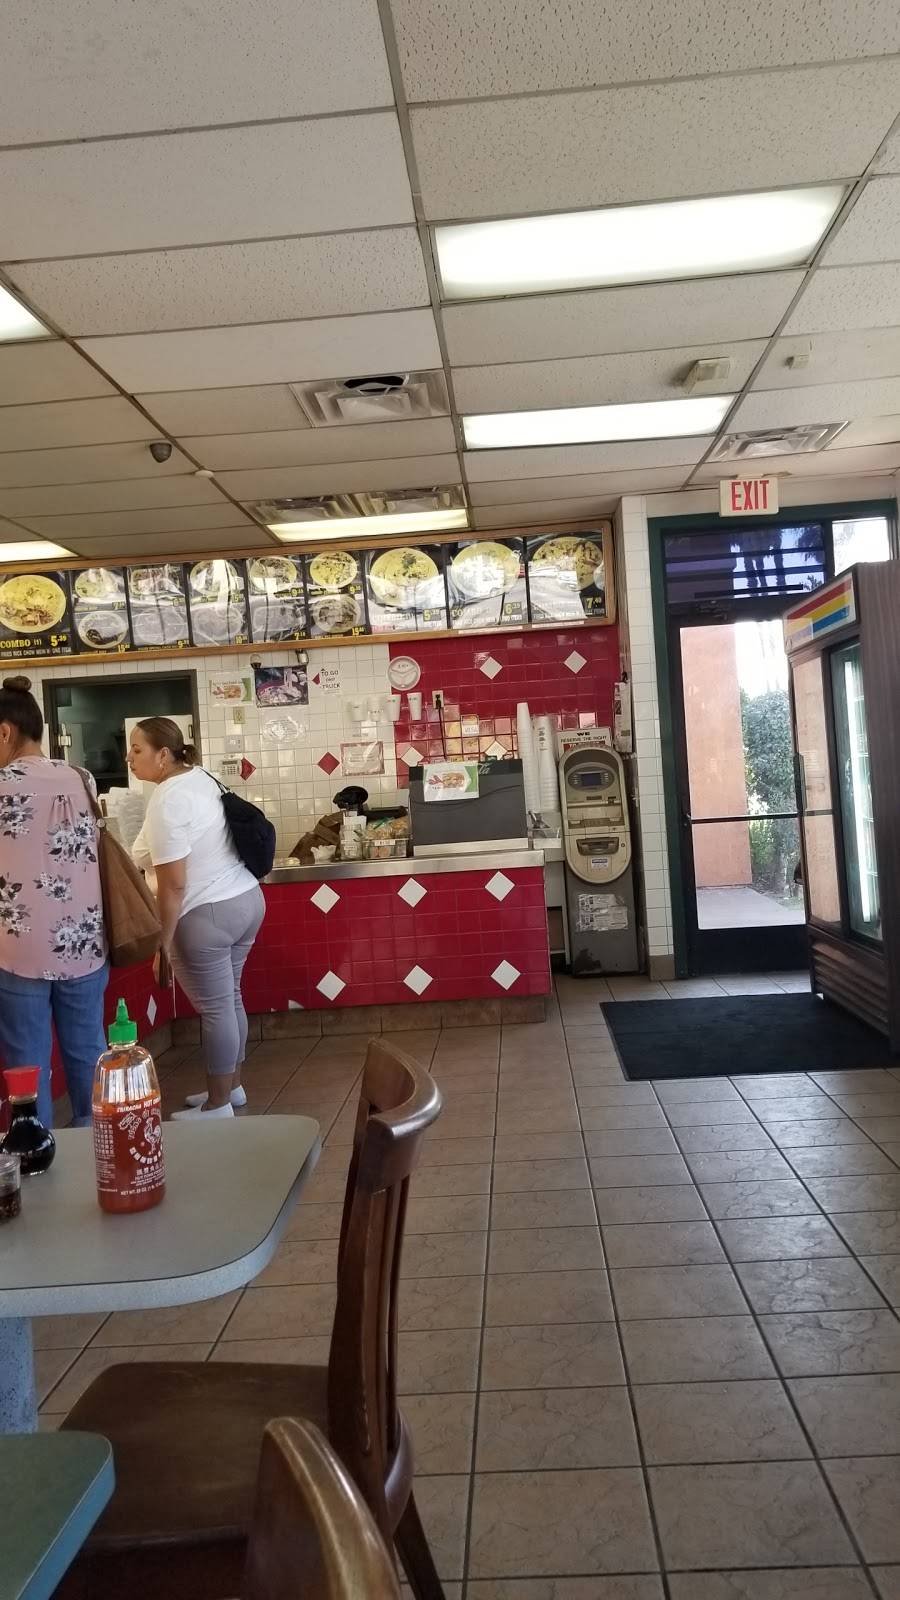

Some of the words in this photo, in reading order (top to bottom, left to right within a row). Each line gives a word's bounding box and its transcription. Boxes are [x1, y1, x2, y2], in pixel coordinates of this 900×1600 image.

[731, 480, 769, 511] EXIT
[0, 639, 31, 649] COMBO
[50, 635, 67, 647] 5.39
